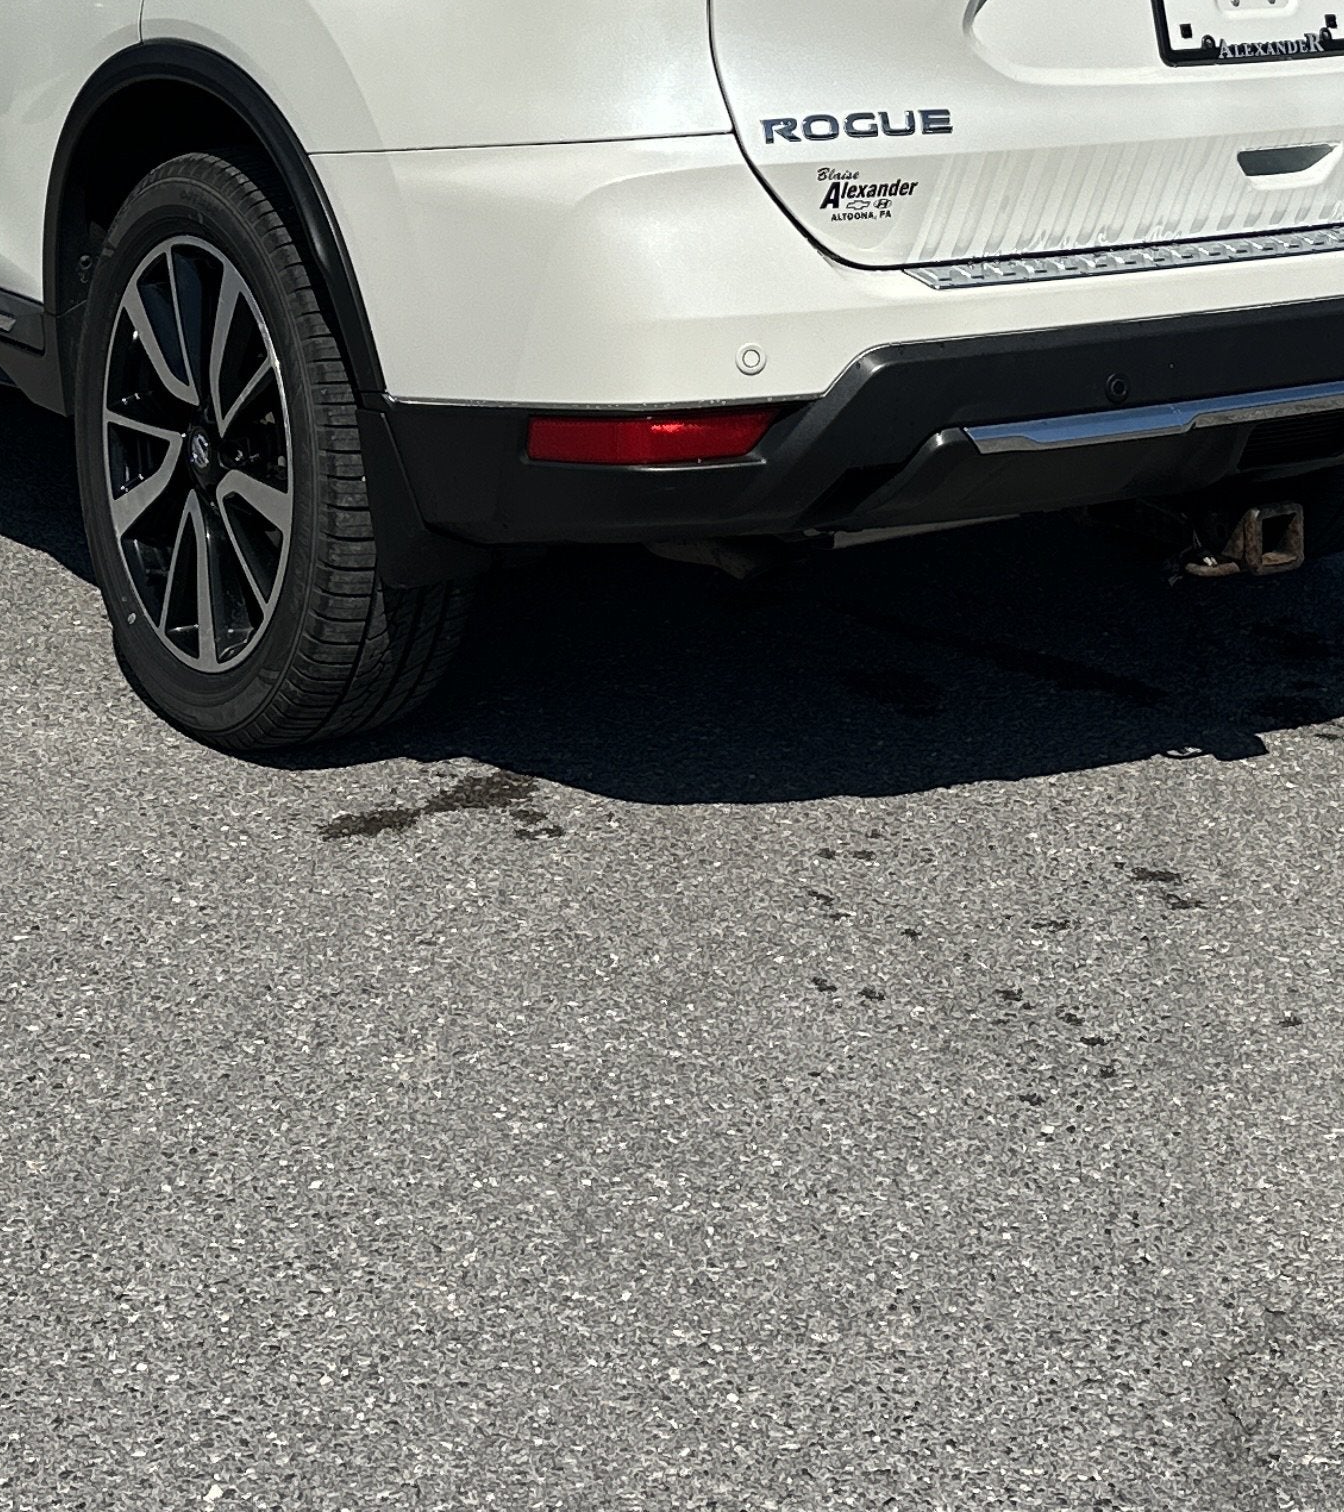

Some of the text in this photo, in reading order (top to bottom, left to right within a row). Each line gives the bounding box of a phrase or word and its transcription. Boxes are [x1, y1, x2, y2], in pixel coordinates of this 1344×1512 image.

[1218, 33, 1325, 59] ALEXANDER
[759, 109, 954, 145] ROGUE
[817, 167, 860, 182] Blaise
[819, 179, 919, 210] Alexander
